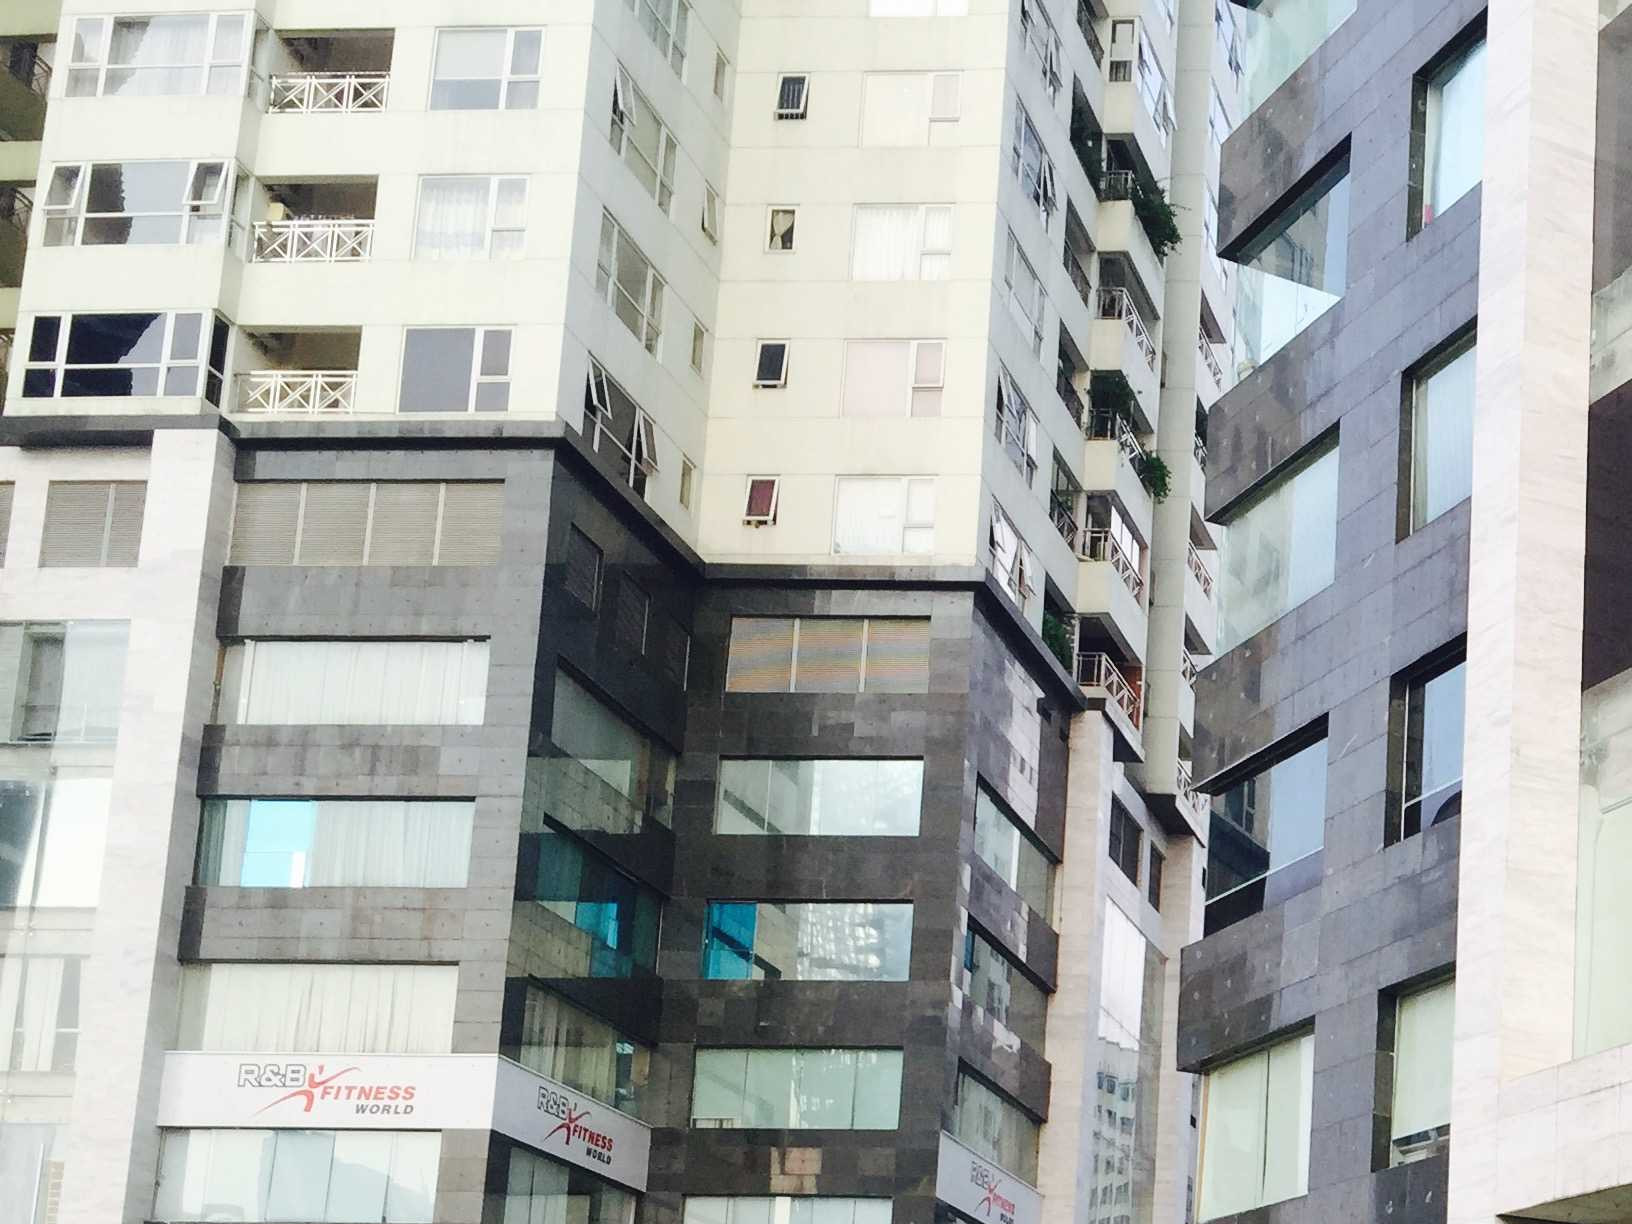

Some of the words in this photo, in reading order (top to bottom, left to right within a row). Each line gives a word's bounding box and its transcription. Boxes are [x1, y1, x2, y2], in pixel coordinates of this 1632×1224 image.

[237, 1063, 308, 1088] R&B
[320, 1085, 417, 1101] FITNESS
[537, 1085, 570, 1121] R&B
[354, 1103, 415, 1115] WORLD
[572, 1124, 614, 1152] FITNESS
[586, 1147, 612, 1165] WORLD
